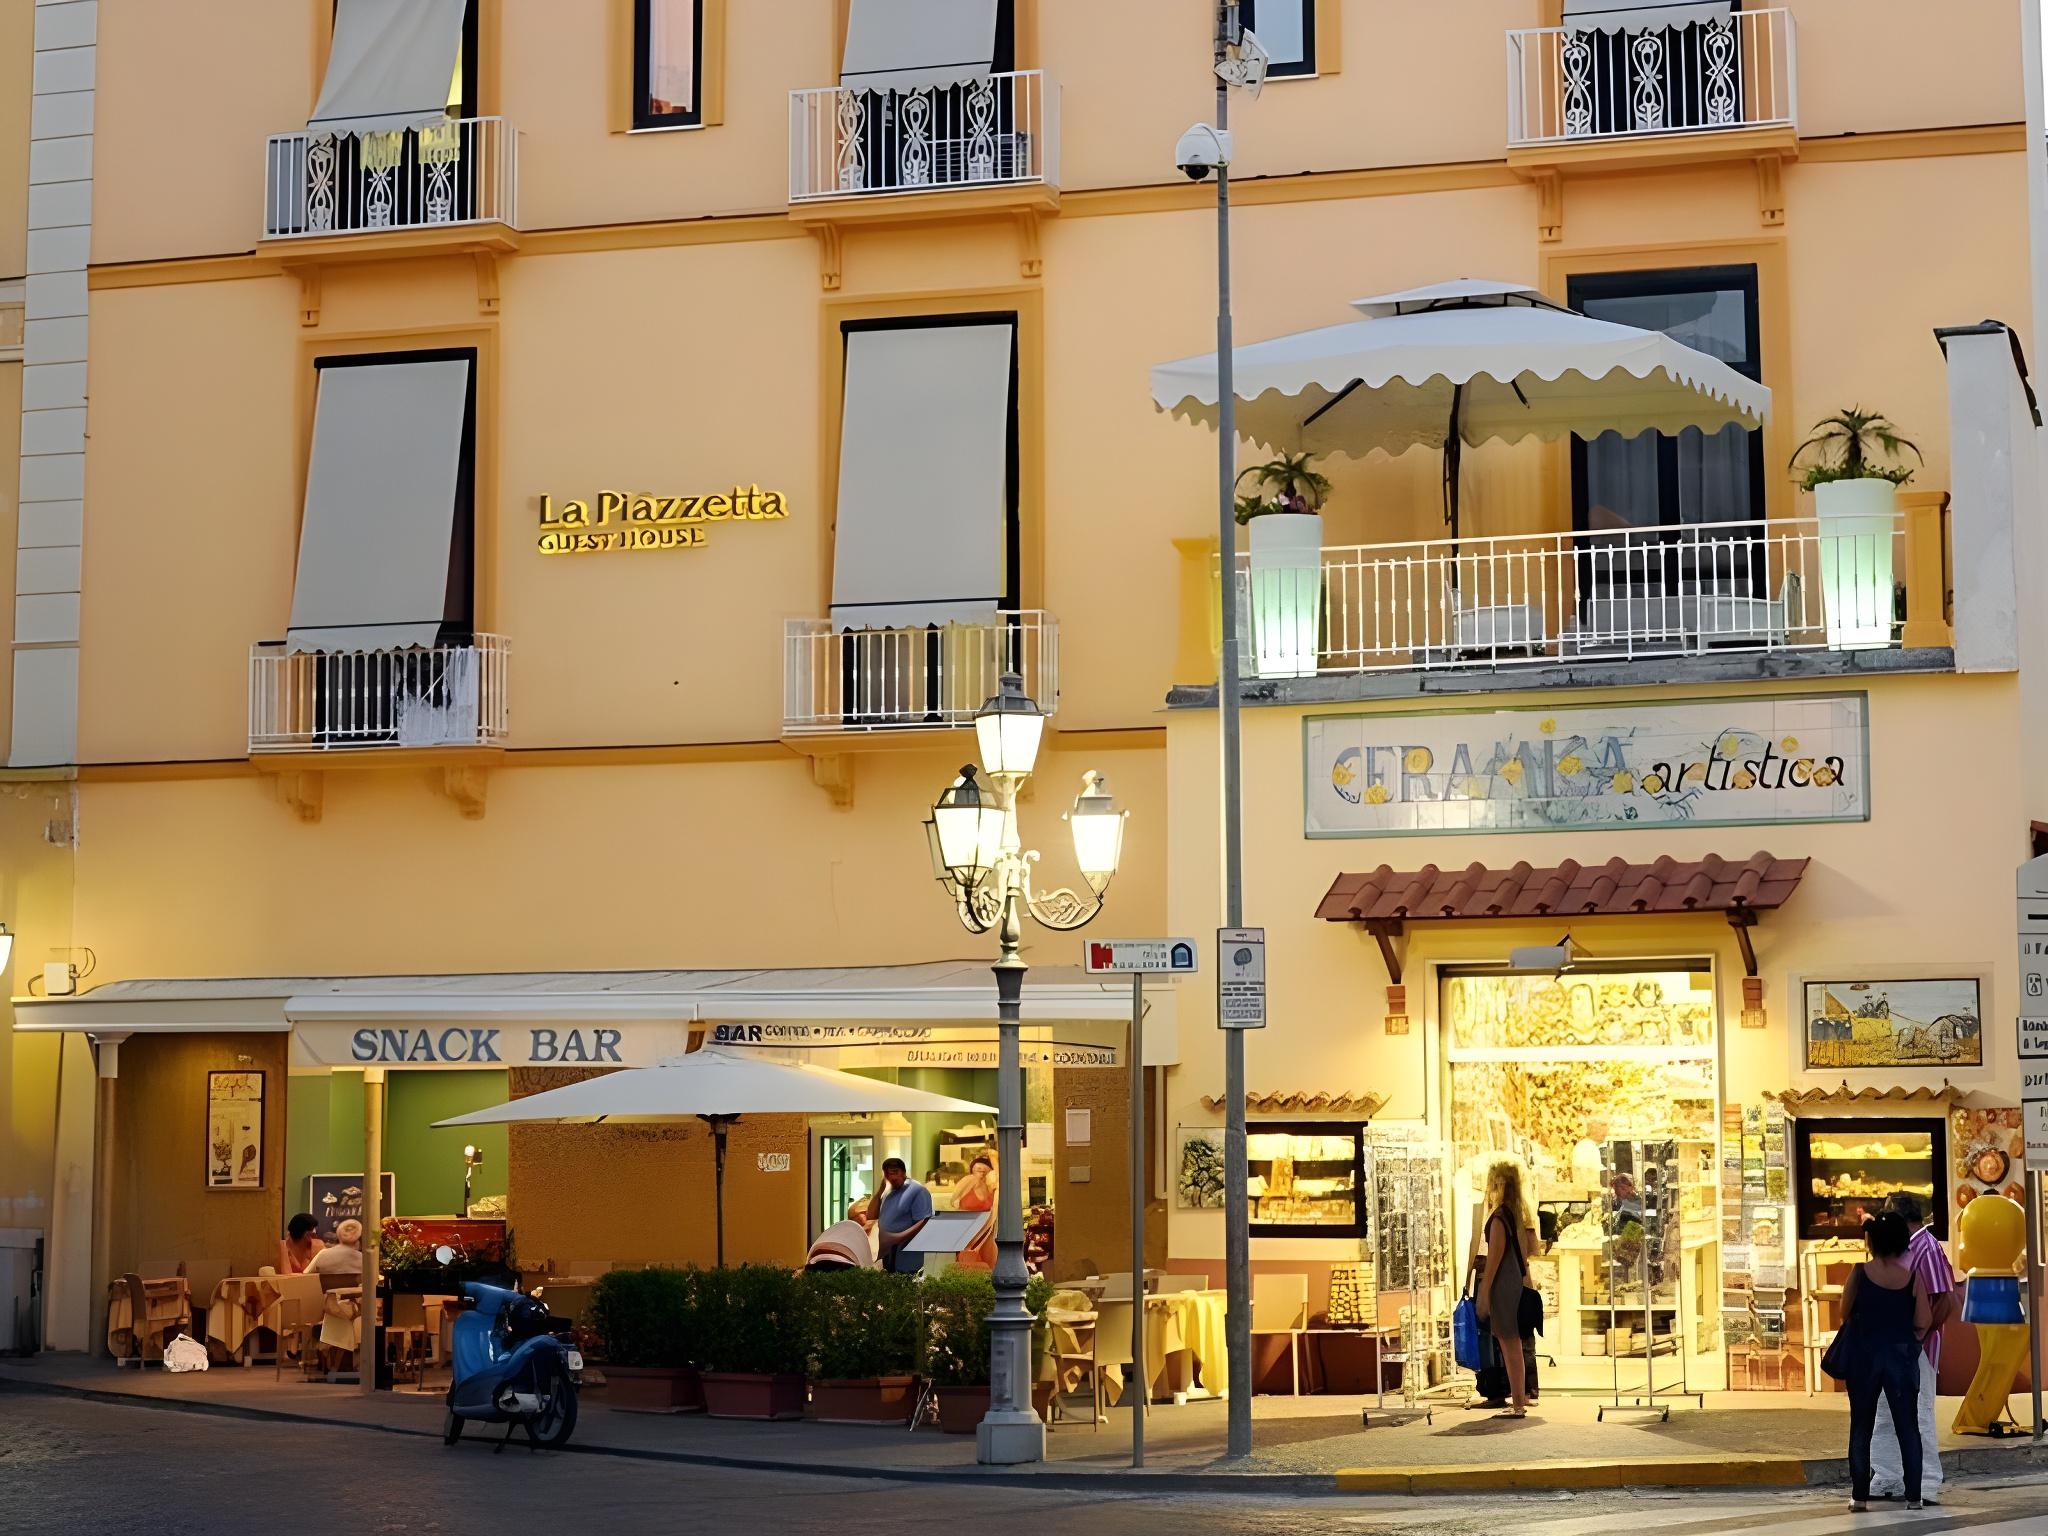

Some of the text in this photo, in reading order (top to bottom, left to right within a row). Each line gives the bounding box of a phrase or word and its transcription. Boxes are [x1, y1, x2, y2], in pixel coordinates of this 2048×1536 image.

[539, 484, 788, 527] La Piazzetta
[538, 528, 708, 553] GUEST HOUSE
[1641, 737, 1845, 793] artistica
[351, 1027, 623, 1062] SNACK BAR
[715, 1025, 762, 1041] BAR
